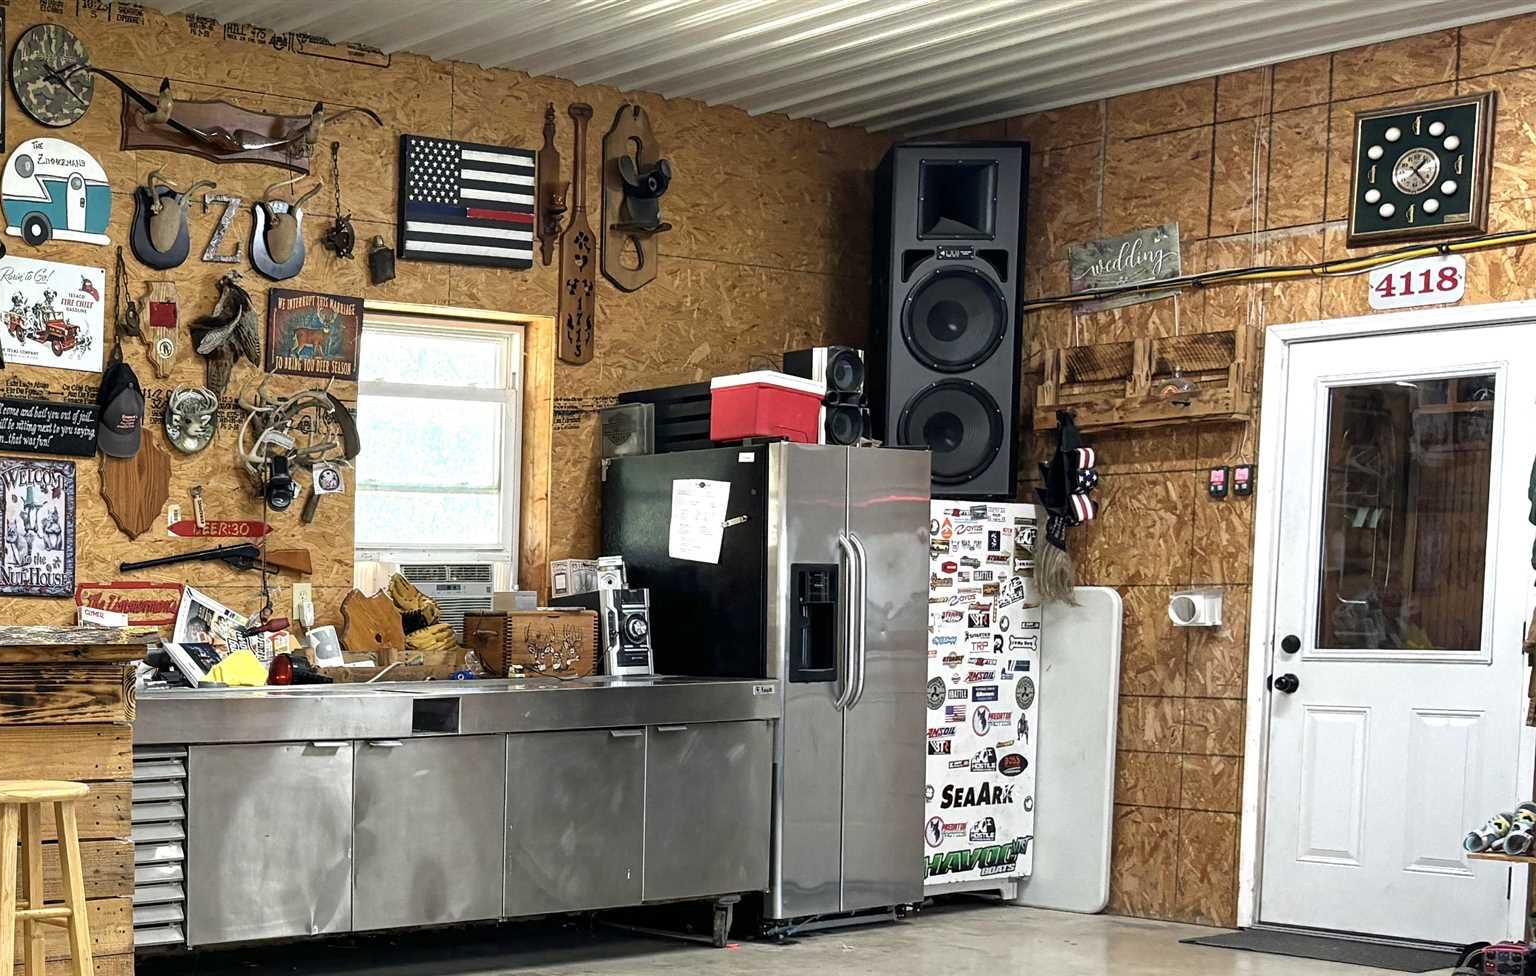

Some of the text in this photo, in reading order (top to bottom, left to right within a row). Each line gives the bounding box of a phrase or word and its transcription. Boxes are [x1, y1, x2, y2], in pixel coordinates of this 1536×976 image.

[1076, 238, 1175, 280] wedding
[1375, 266, 1458, 298] 4118
[2, 467, 67, 491] WELCOM
[980, 864, 1016, 876] BOATS
